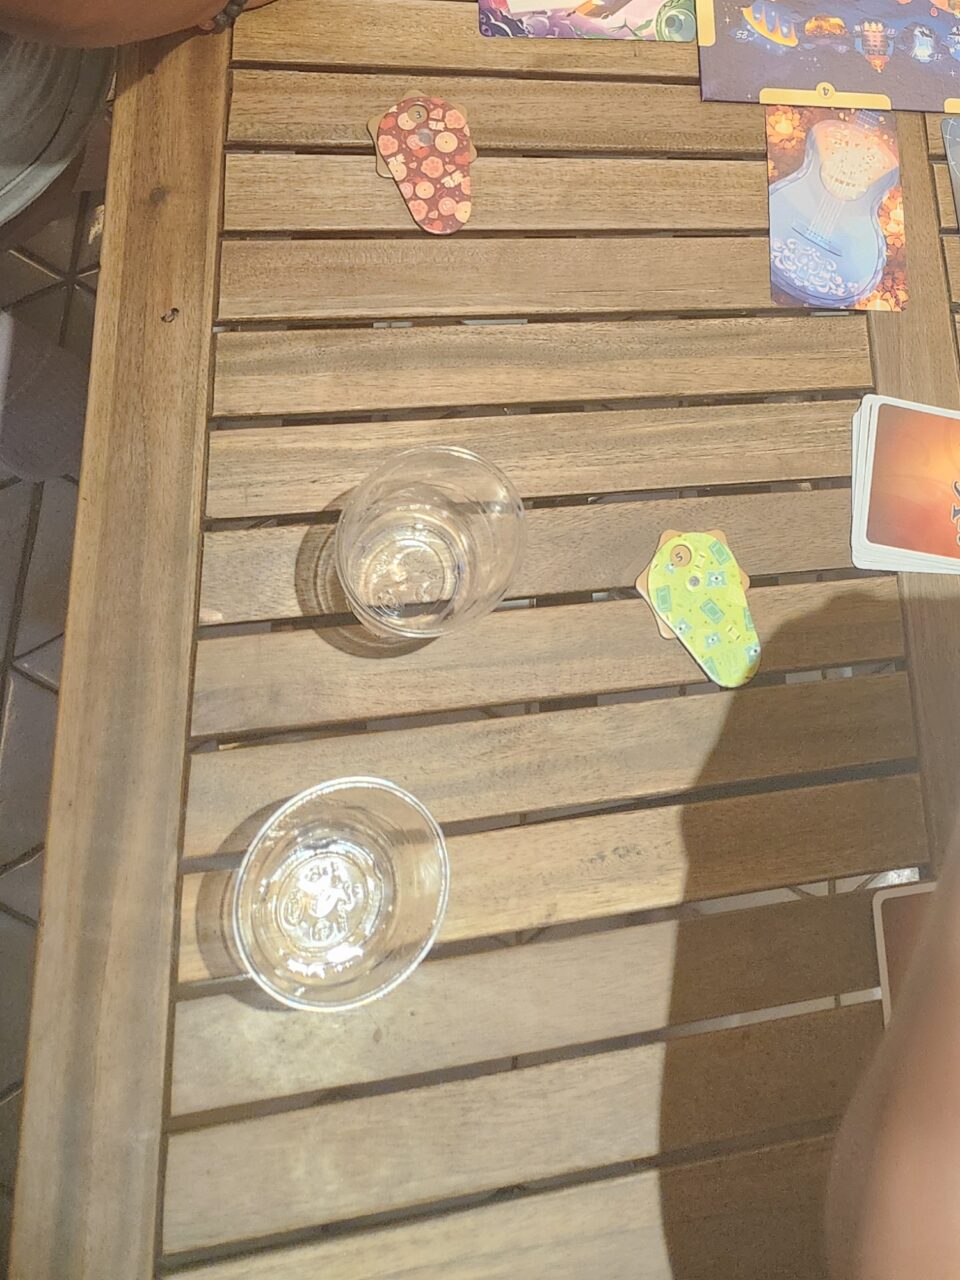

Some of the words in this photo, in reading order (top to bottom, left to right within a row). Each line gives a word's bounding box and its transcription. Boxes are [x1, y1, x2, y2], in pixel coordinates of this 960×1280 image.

[822, 86, 829, 95] 4
[415, 110, 421, 119] 3
[675, 552, 683, 562] 5
